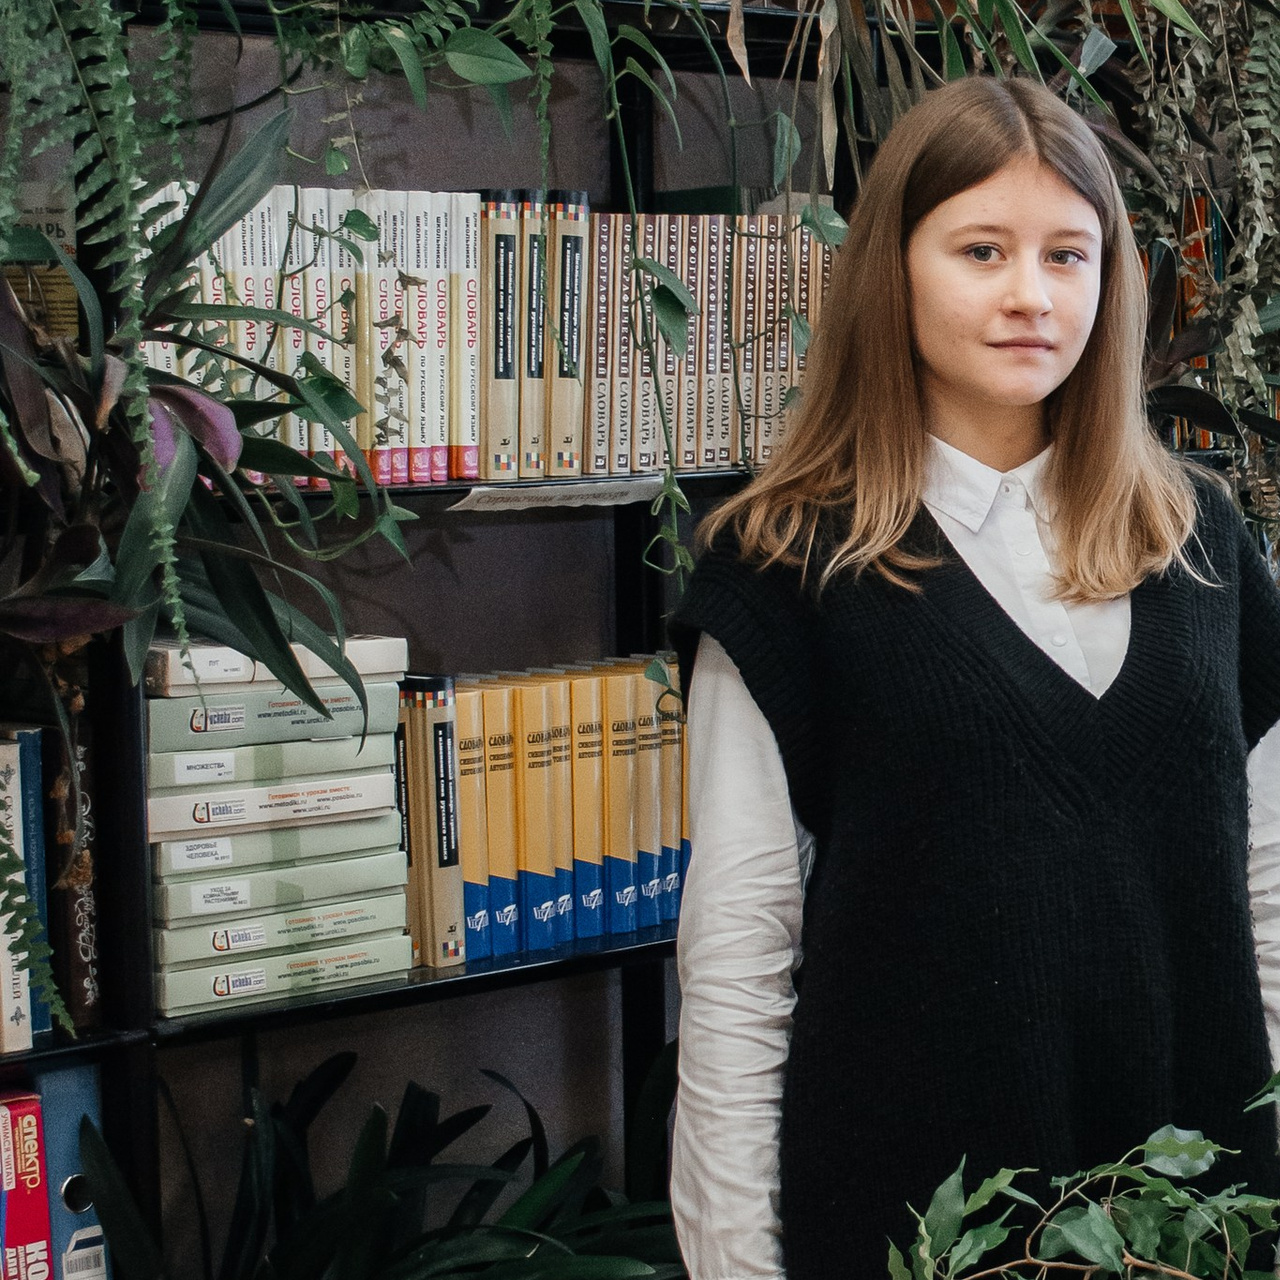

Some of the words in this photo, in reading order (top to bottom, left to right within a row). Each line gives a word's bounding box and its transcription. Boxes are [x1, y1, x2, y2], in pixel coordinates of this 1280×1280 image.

[244, 277, 256, 351] СЛОАРЬ
[291, 276, 302, 349] СЛОВРЬ
[379, 279, 388, 350] СЛОВРЬ
[436, 279, 447, 349] СЛОВАРЬ
[467, 279, 477, 348] СЛОВАРЬ
[597, 223, 608, 375] ОРФОГРАФИЧЕСКИЙ
[686, 225, 698, 373] ОРФОГРАЧЕСКИЙ
[707, 224, 718, 373] ОРФОГРАФИЧЕСКИЙ
[420, 355, 426, 367] ПО
[439, 354, 445, 367] ПО
[470, 354, 476, 367] ПО
[597, 381, 606, 447] СЛОВАРЬ
[619, 380, 629, 446] СЛОВАРЬ
[641, 380, 650, 446] СЛОВАРЬ
[686, 379, 695, 443] СЛОВАРЬ
[706, 377, 715, 441] СЛОВАРЬ
[721, 376, 730, 440] СЛОВАРЬ
[764, 375, 773, 438] СЛОВАРЬ
[257, 709, 307, 719] www.metodiki.ru
[186, 762, 225, 771] МНОЖЕСТВА
[258, 799, 308, 810] www.metodiki.ru
[316, 792, 363, 803] www.posobie.ru
[267, 791, 301, 800] Готовимся
[306, 789, 329, 798] урокам
[292, 804, 331, 814] www.uroki.ru
[185, 841, 218, 852] ЗДОРОВЬЕ
[185, 850, 219, 860] ЧЕЛОВЕКА
[277, 923, 324, 934] www.metodiki.ru
[277, 966, 326, 979] www.metodiki.ru
[1, 1113, 11, 1152] УЧИМСЯ
[3, 1153, 13, 1186] ЧИТАТЬ
[5, 1247, 18, 1276] ДЛЯ
